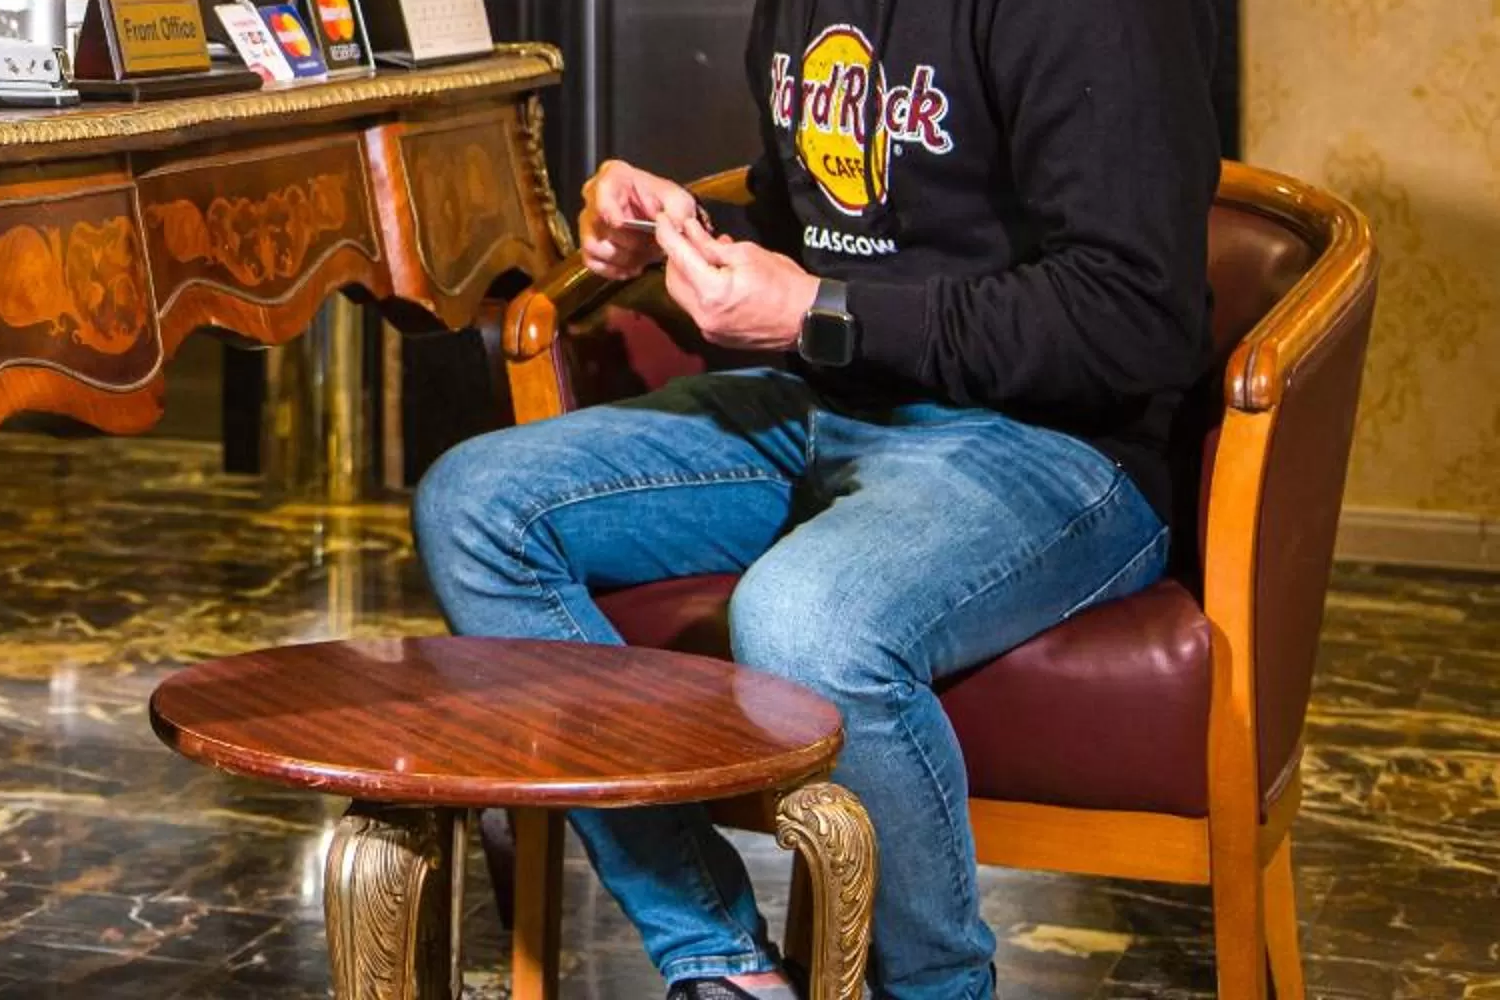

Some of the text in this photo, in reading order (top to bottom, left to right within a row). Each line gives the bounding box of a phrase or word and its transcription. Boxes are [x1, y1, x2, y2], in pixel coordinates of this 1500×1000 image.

[123, 14, 196, 41] Front Office
[803, 225, 898, 256] GLASGOW
